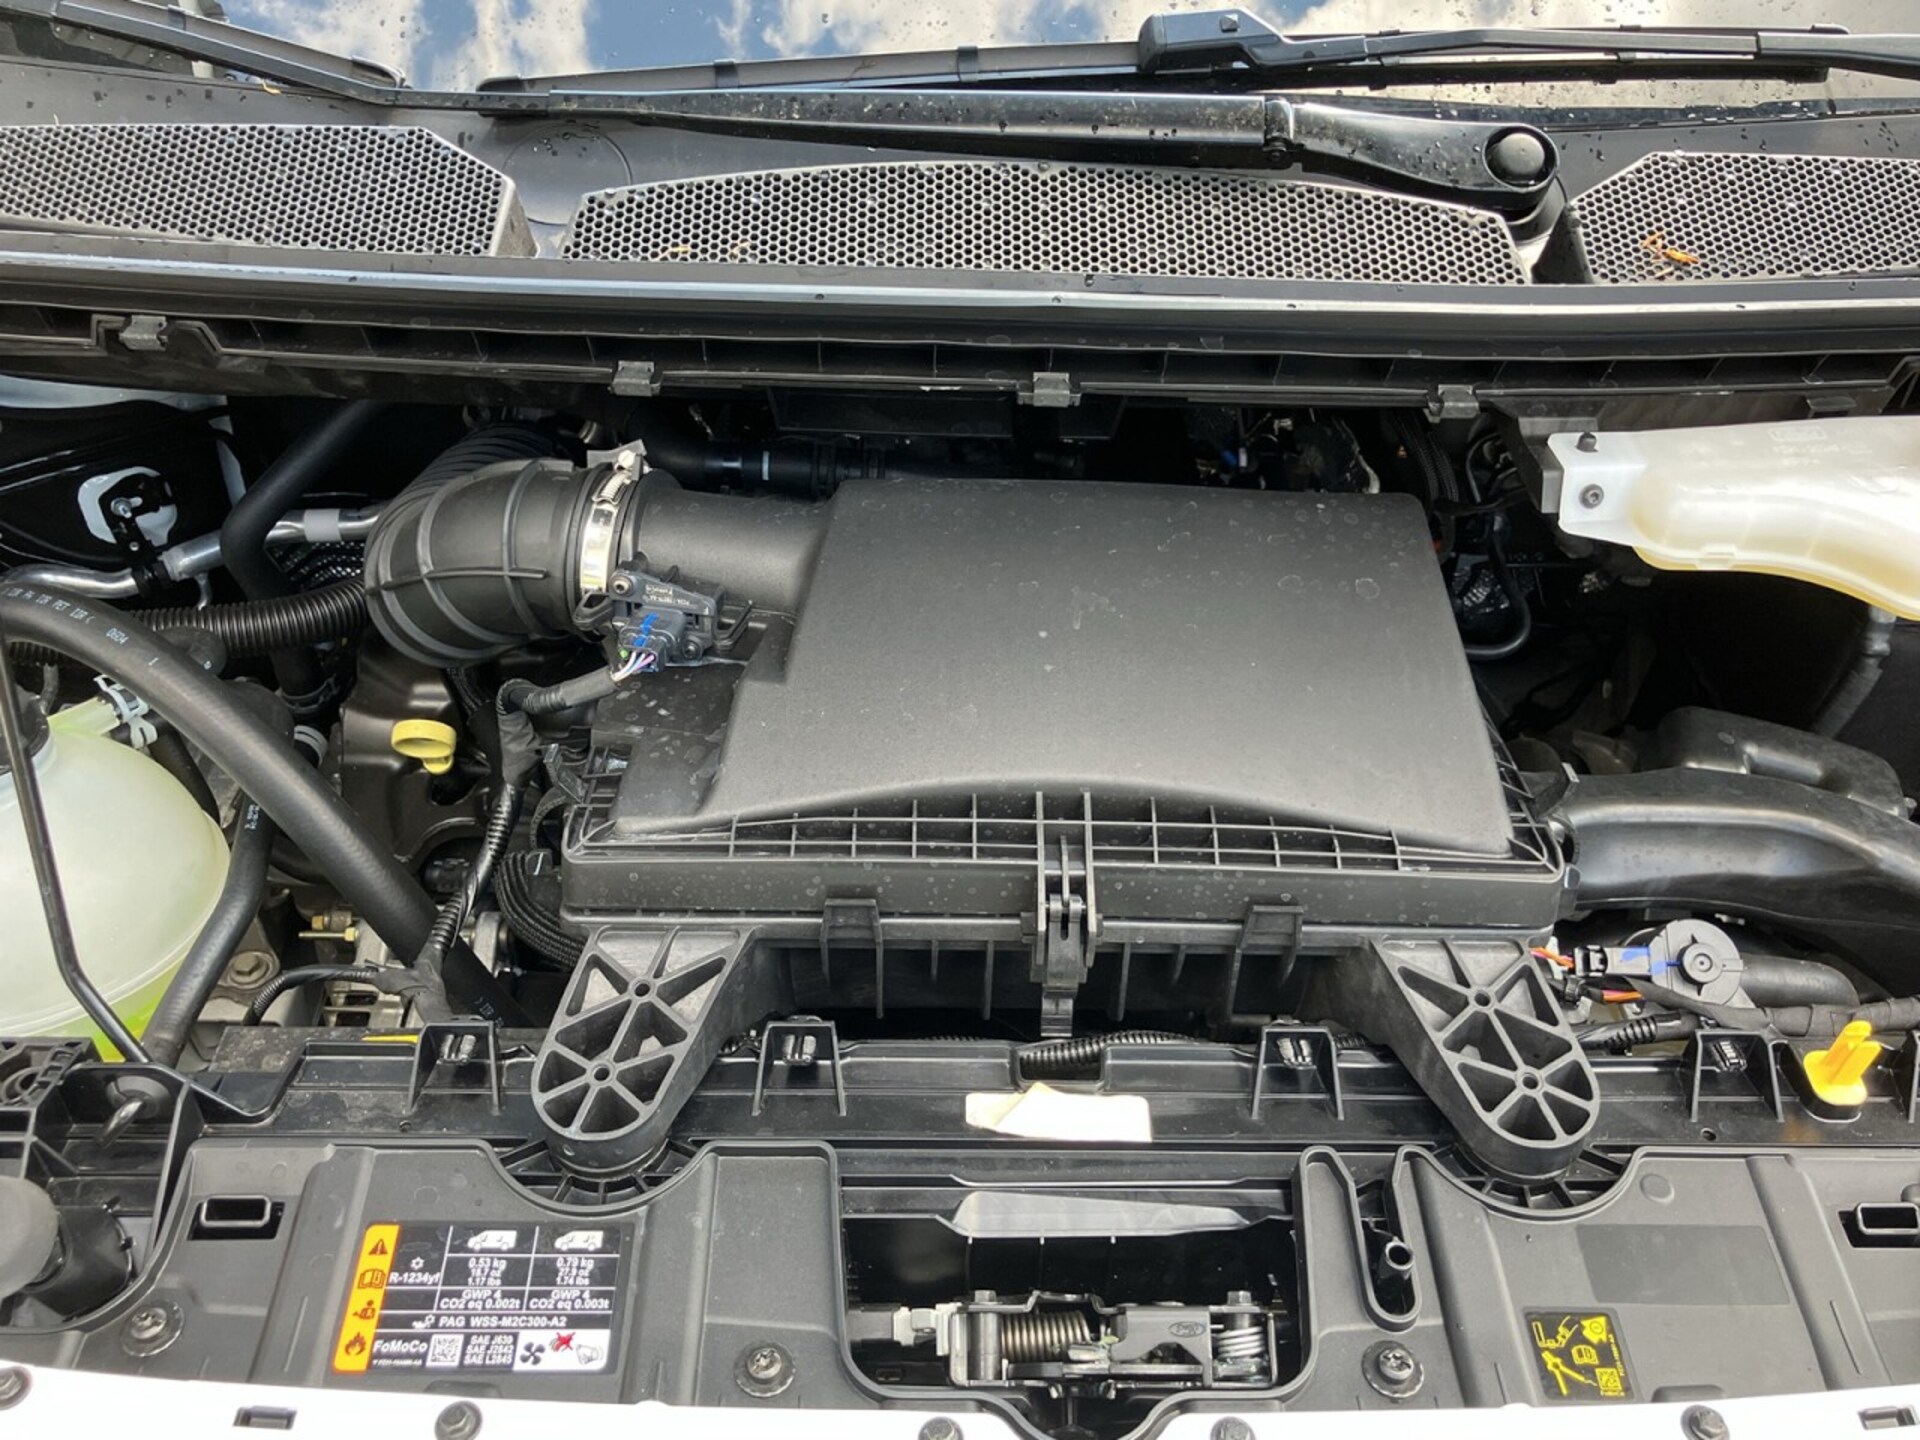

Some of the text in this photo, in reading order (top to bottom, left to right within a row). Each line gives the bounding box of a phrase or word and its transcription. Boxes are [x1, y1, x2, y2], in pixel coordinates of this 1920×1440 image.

[468, 1257, 507, 1271] 0.53 kg
[556, 1257, 595, 1271] 0.79 kg
[388, 1271, 442, 1285] R-1234yf
[468, 1277, 502, 1286] 1.17 lbs
[556, 1276, 590, 1286] 1.74 lbs
[462, 1289, 502, 1299] GWP 4
[551, 1289, 590, 1299] GWP 4
[440, 1298, 520, 1311] CO2 eq 0.002t
[529, 1298, 609, 1311] CO2 eq 0.003t
[438, 1316, 568, 1327] PAG WSS-M2C300-A2
[373, 1339, 428, 1352] FoMoCo
[470, 1335, 491, 1345] SAE
[466, 1344, 487, 1354] SAE
[463, 1353, 485, 1365] SAE
